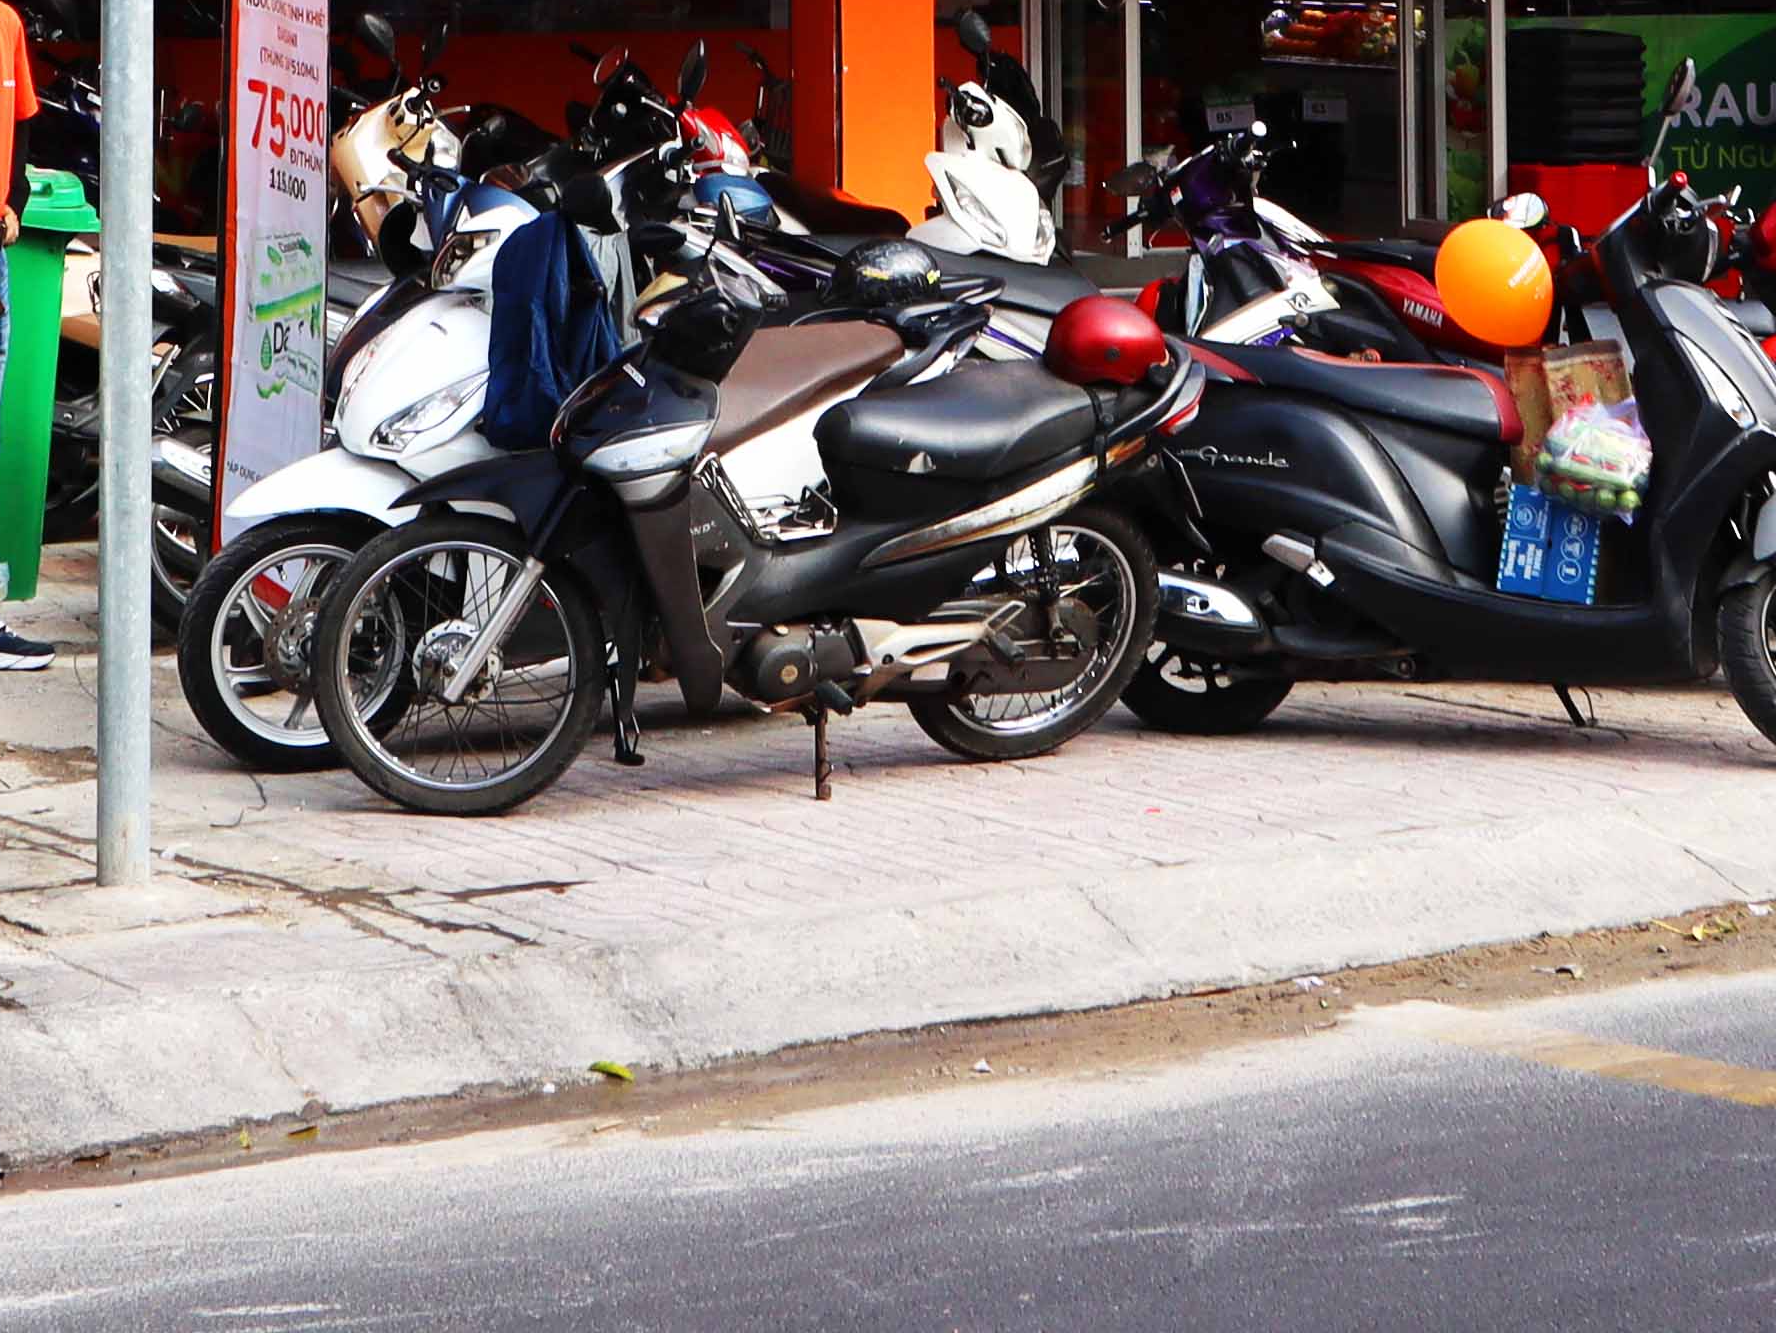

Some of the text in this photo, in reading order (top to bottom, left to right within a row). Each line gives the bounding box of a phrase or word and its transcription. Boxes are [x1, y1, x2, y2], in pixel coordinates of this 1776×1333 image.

[247, 79, 325, 159] 75.000
[1402, 296, 1444, 329] YAMAHA
[1199, 445, 1289, 469] Grande
